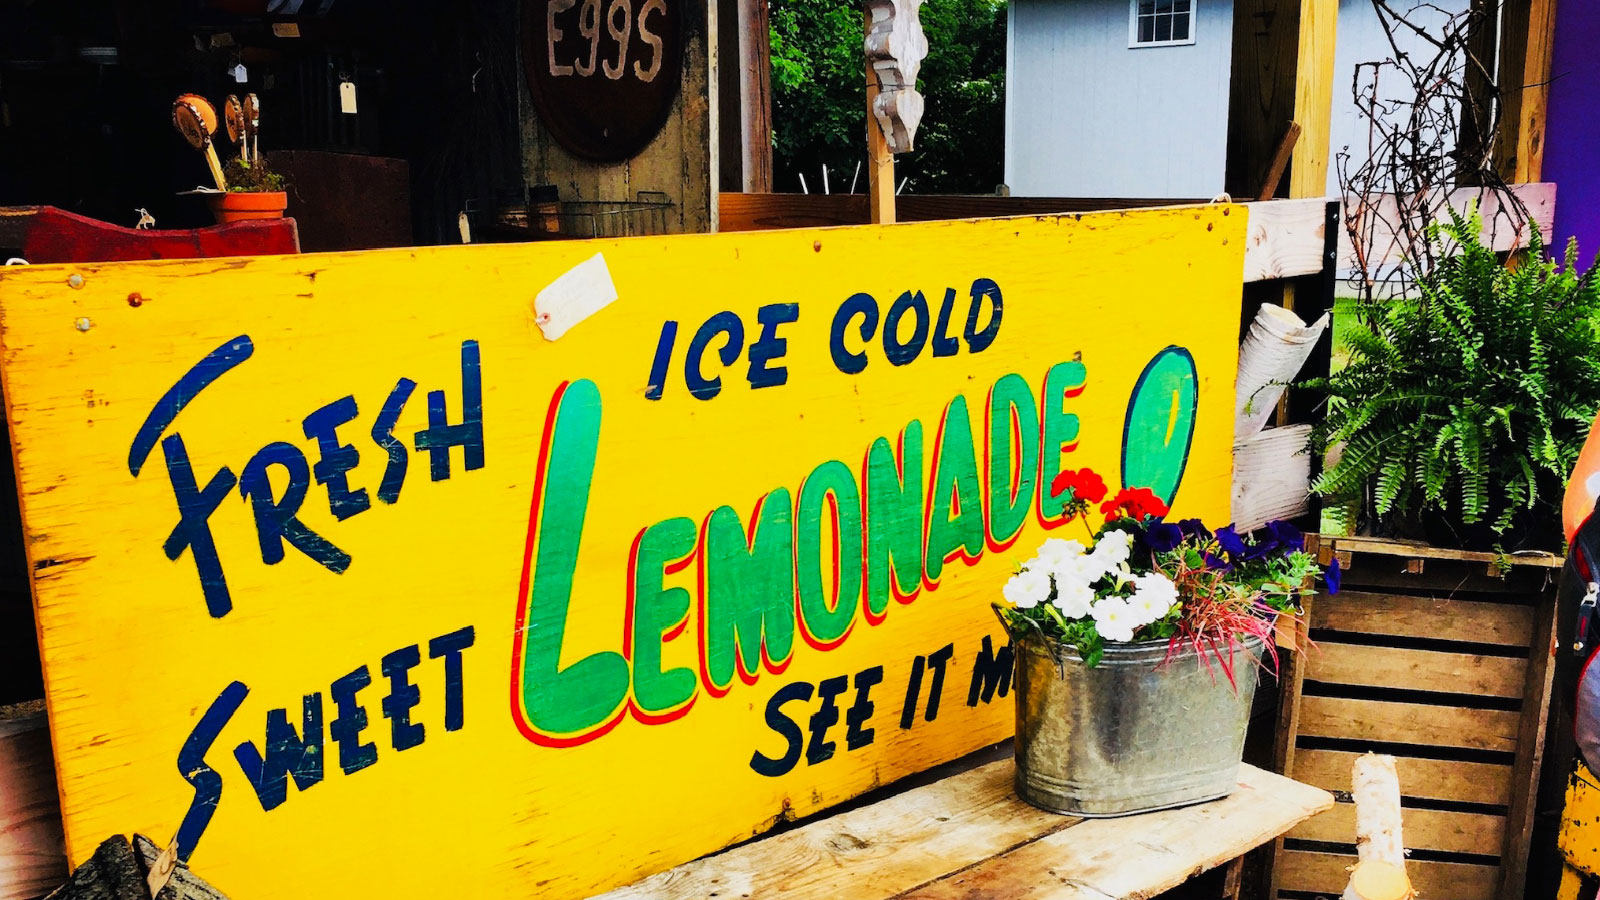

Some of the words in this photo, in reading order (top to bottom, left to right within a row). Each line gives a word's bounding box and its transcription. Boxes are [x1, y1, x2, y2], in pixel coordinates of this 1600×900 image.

[645, 302, 799, 401] ICE
[830, 278, 1004, 375] COLD
[128, 334, 485, 618] FRESH
[510, 360, 1087, 748] LEMONADE
[176, 625, 476, 863] SWEET
[749, 665, 883, 777] SEE
[900, 642, 954, 730] IT
